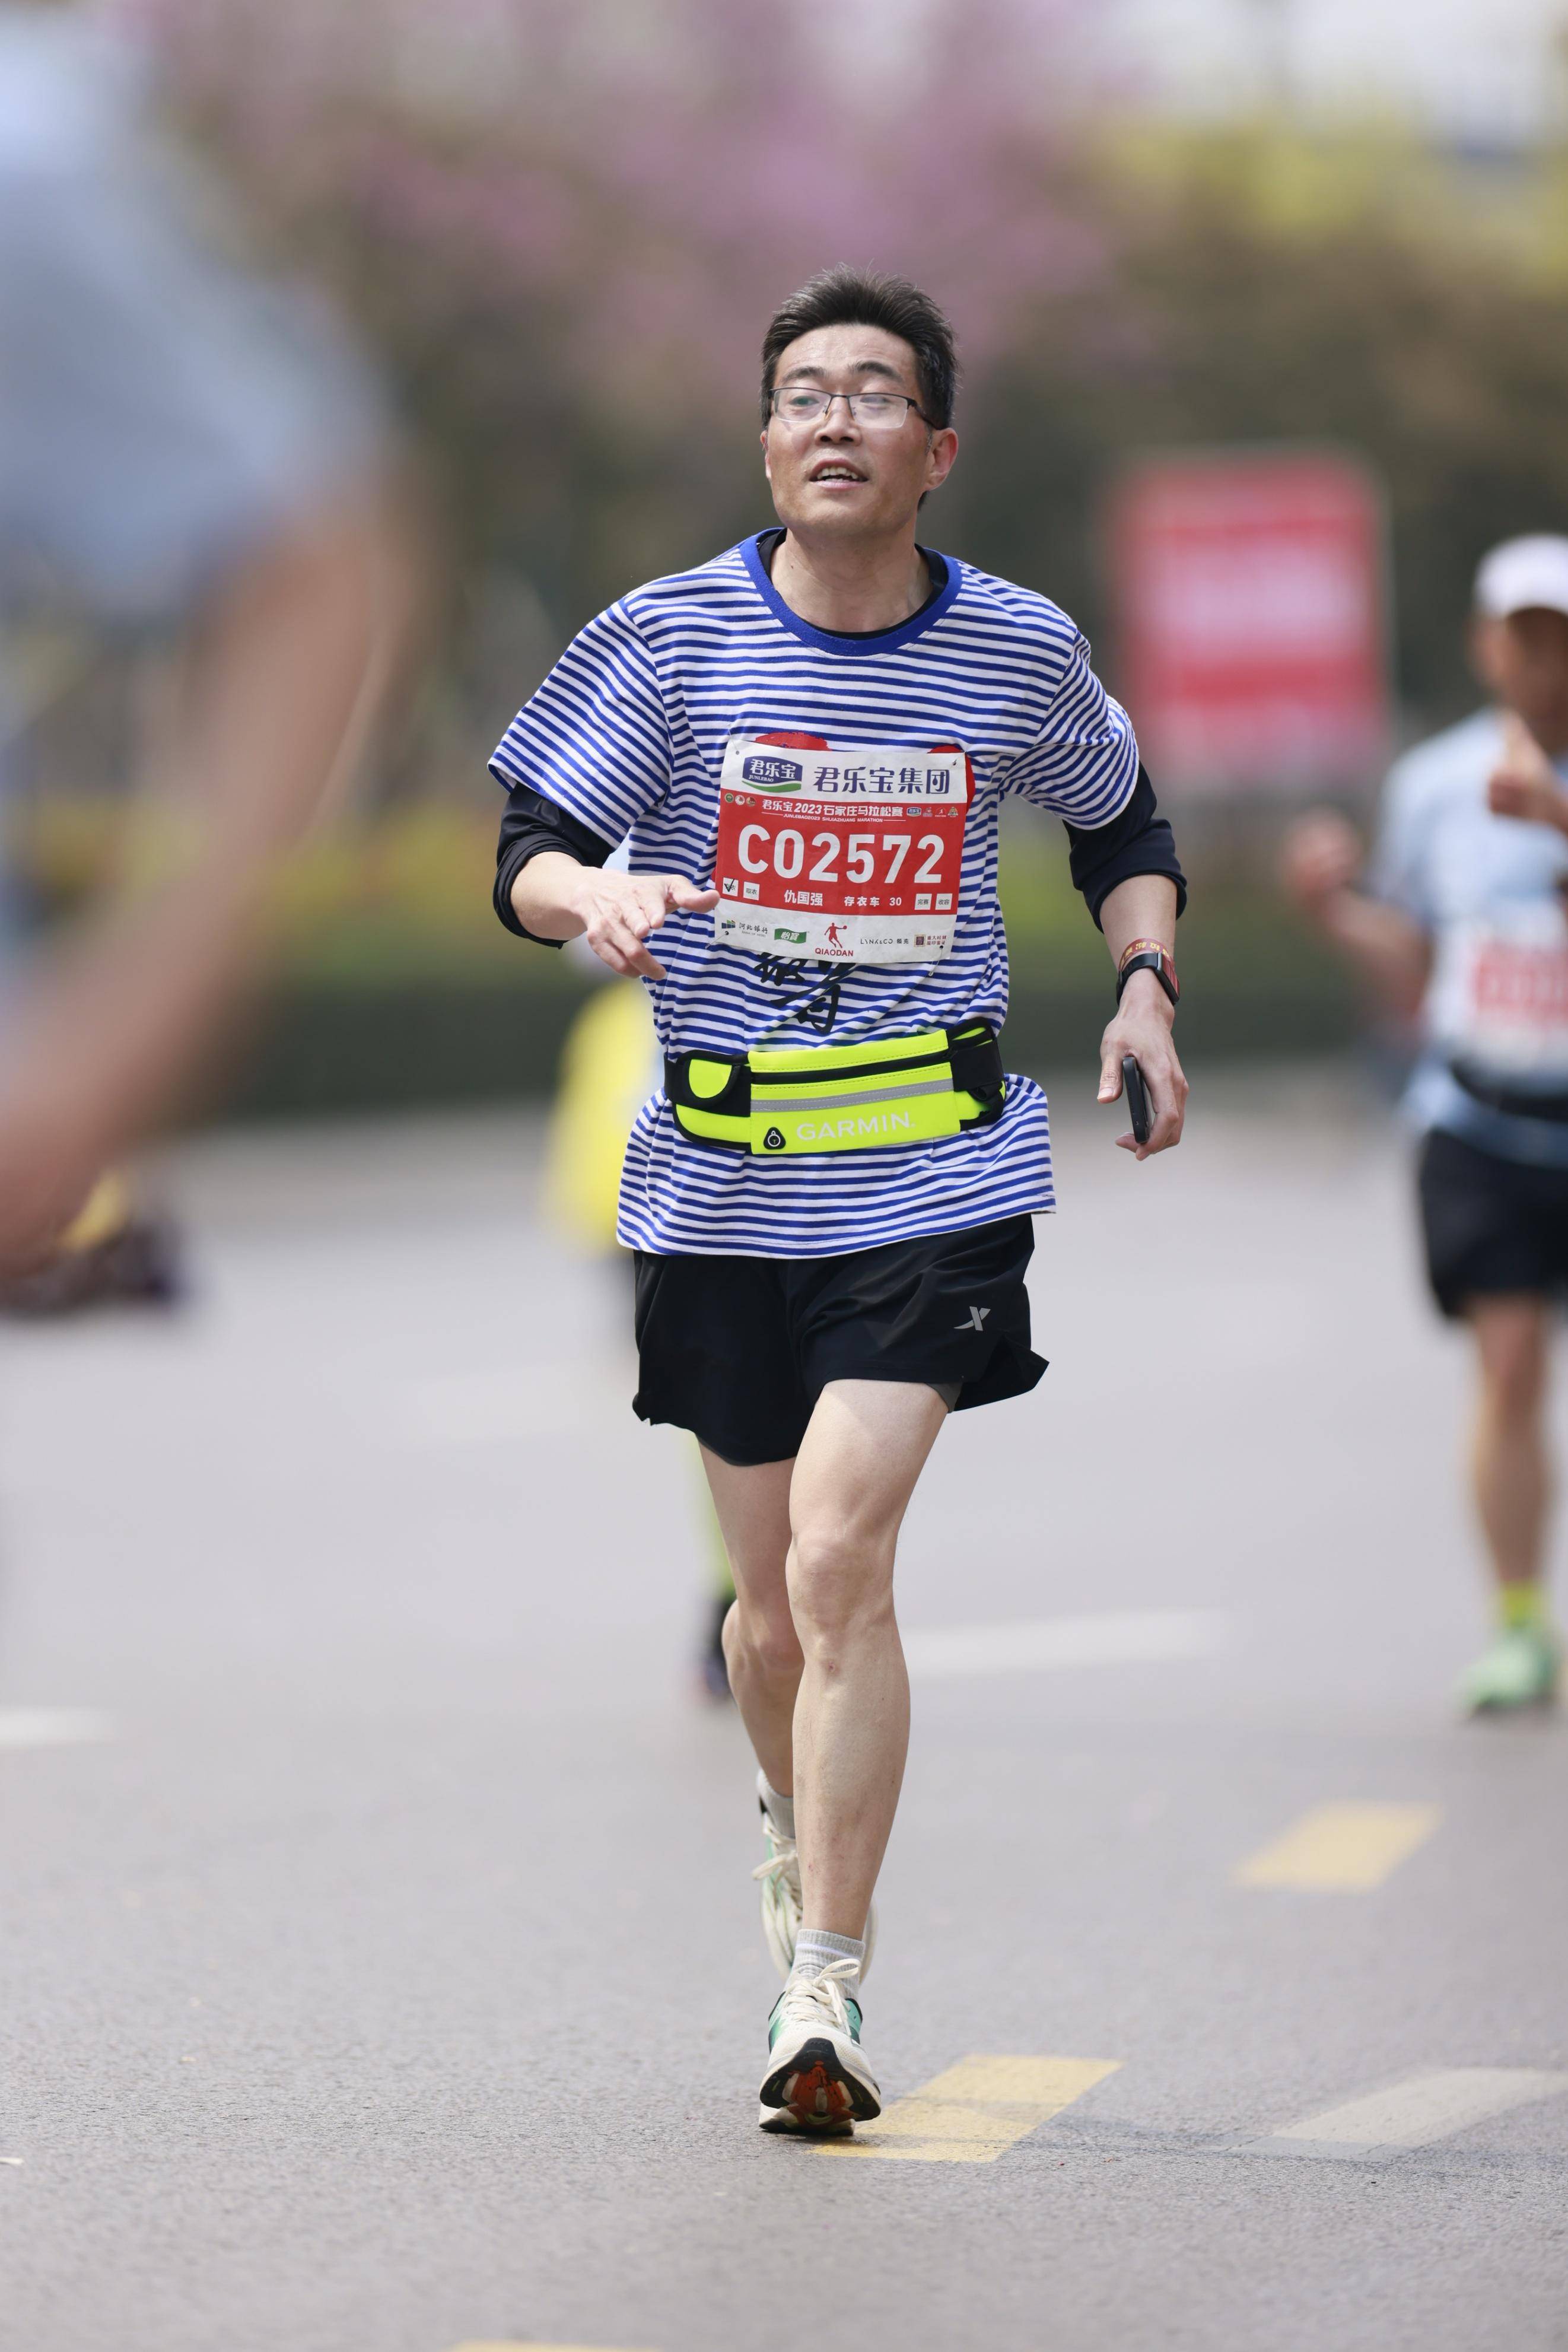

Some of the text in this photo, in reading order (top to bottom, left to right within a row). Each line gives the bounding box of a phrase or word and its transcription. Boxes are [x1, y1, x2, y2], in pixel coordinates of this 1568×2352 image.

[750, 759, 796, 779] 君乐宝
[813, 767, 949, 794] 君乐宝集团
[738, 824, 944, 883] C02572
[784, 889, 823, 906] 仇国强
[844, 896, 902, 907] 存衣车 30
[739, 922, 768, 934] 河北银行
[815, 948, 854, 956] QIAODAN
[797, 1111, 909, 1141] GARMIN
